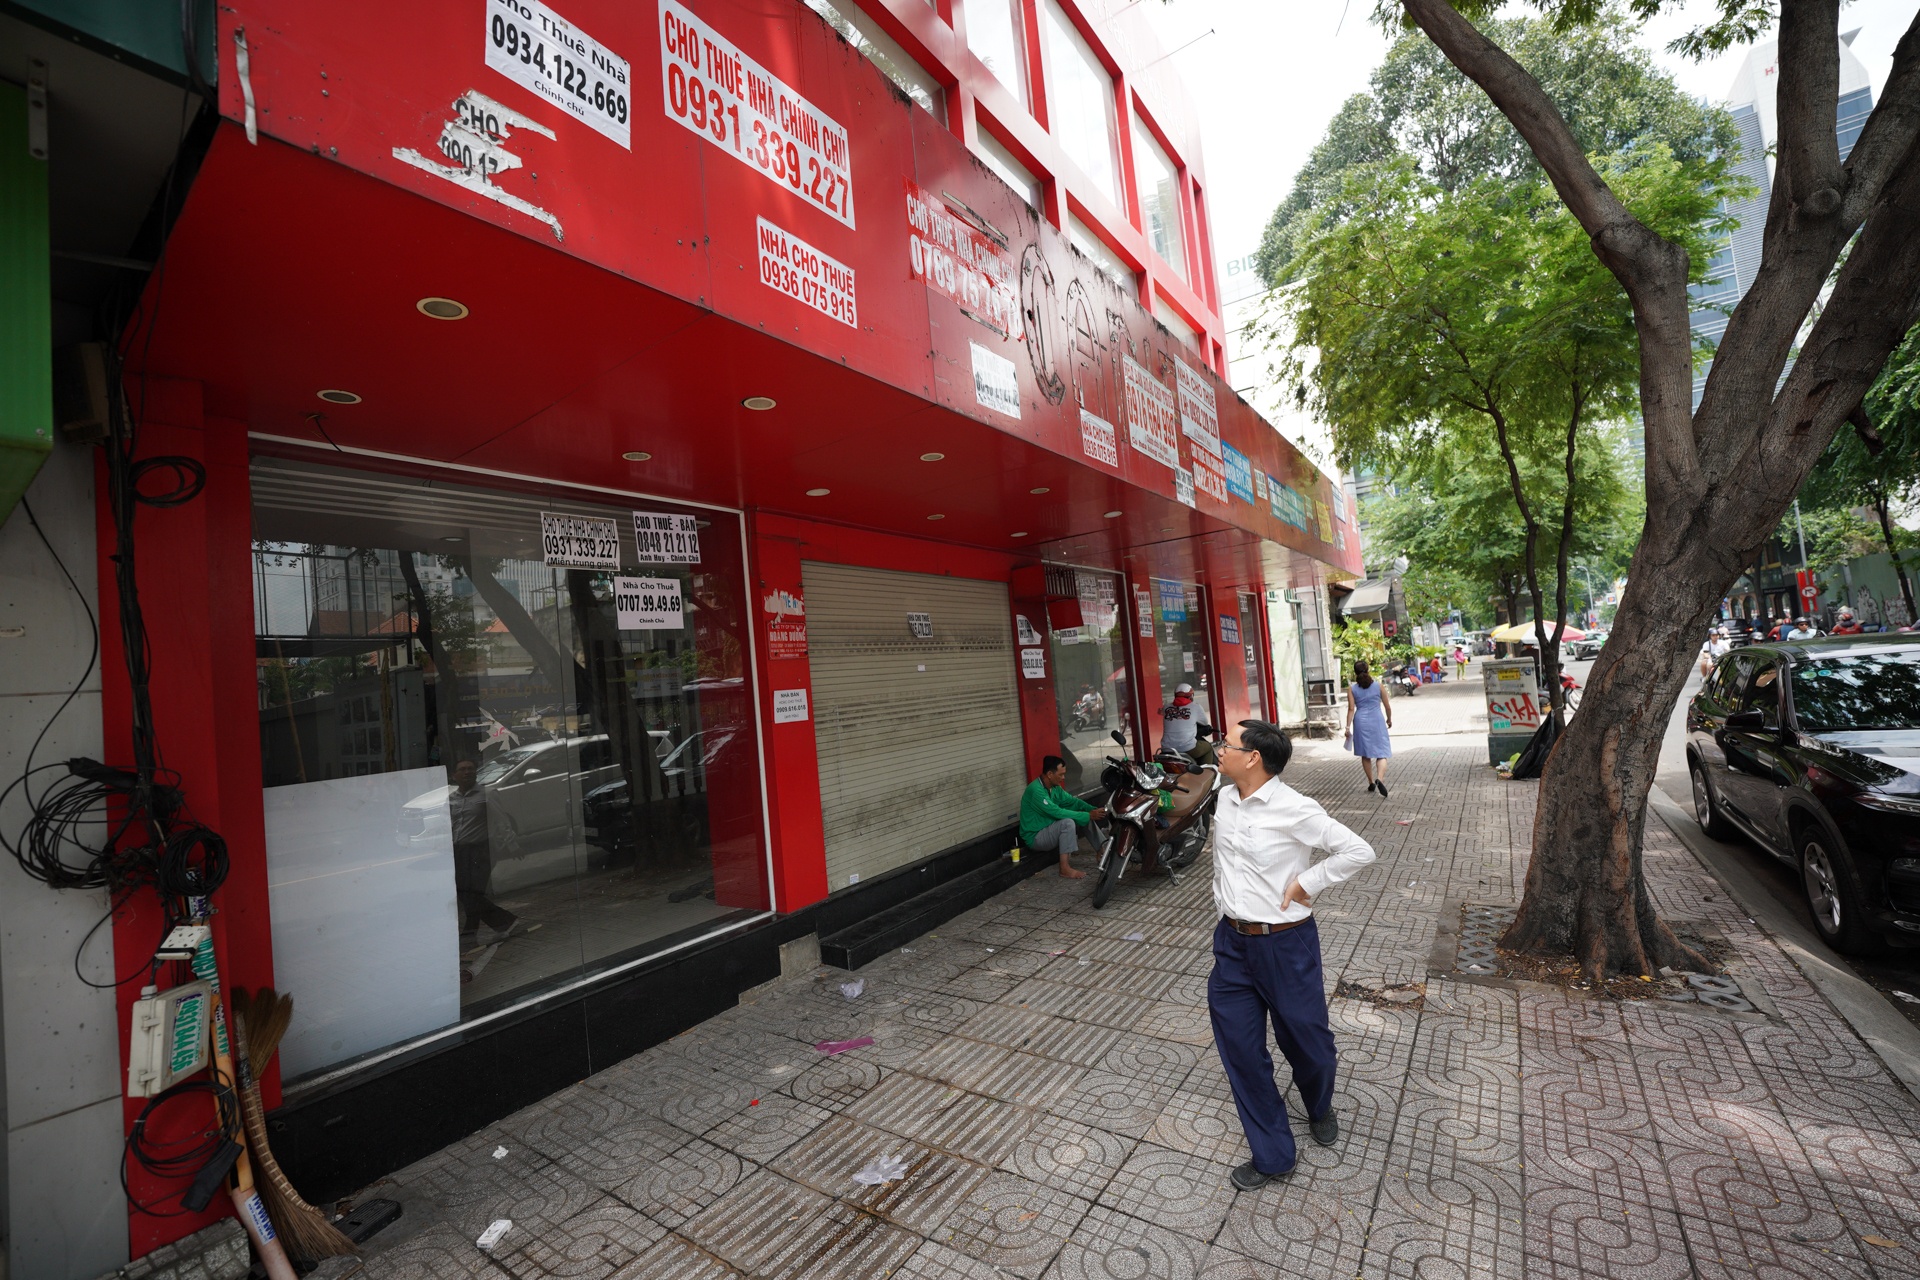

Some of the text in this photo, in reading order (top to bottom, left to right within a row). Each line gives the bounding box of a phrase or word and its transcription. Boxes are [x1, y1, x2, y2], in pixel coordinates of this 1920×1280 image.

[498, 0, 627, 85] ho Thuê Nhà
[492, 14, 628, 124] 0934.122.669
[534, 80, 585, 116] Chính chủ
[664, 10, 848, 173] CHO THUÊ NHÀ CHÍNH CHỦ
[668, 62, 850, 219] 0931.339.227
[907, 193, 929, 234] CHO
[929, 209, 955, 252] THUÊ
[955, 228, 975, 265] NHÀ
[760, 225, 854, 298] NHÀ CHO THUÊ
[910, 233, 957, 294] 0789
[957, 265, 980, 309] 75
[761, 255, 855, 325] 0936 075 915
[1177, 364, 1215, 409] NHÀ CHO THUÊ
[1081, 420, 1115, 448] NHÀ CHO THUÊ
[635, 515, 651, 530] CHO
[652, 515, 673, 531] THUÊ
[680, 516, 696, 532] BÁN
[637, 531, 699, 554] 0848 21 21 12
[544, 534, 618, 559] 0931.339.227
[572, 559, 595, 569] trung
[596, 560, 617, 570] gian)
[640, 554, 652, 562] Anh
[654, 554, 665, 563] Huy
[617, 594, 681, 612] 0707.99.49.69
[623, 581, 675, 591] Nhà Cho Thuê
